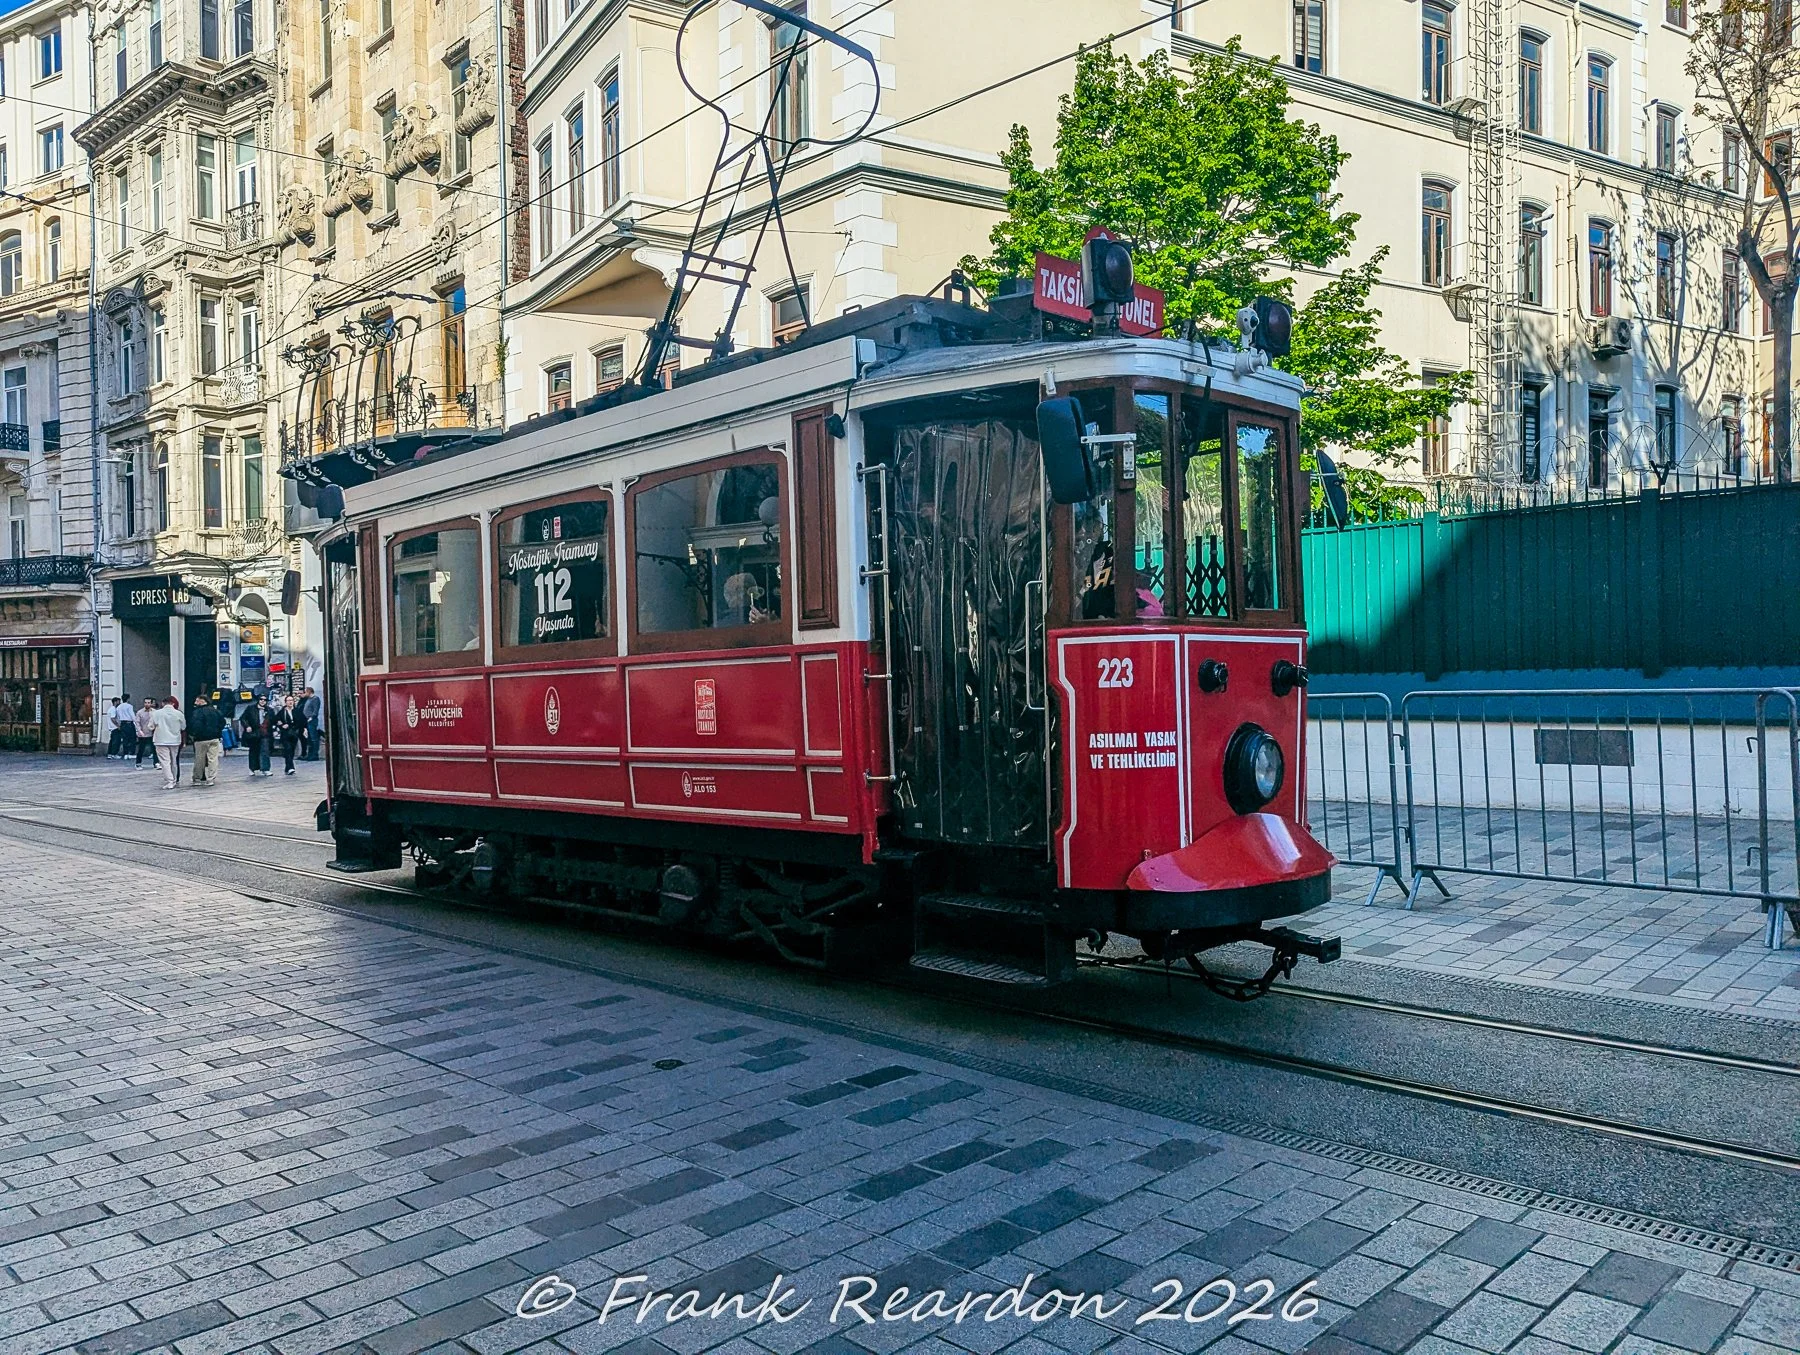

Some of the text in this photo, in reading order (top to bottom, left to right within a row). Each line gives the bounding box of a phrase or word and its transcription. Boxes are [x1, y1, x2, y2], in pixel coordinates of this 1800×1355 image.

[508, 541, 599, 575] Nostaljik Tramvay
[130, 587, 189, 606] ESPRESS LAB
[534, 567, 572, 615] 112
[534, 614, 574, 638] Yaşında
[1097, 657, 1134, 689] 223
[420, 703, 463, 722] BÜYÜKŞEHİR
[1144, 731, 1177, 747] YASAK
[1090, 749, 1176, 769] VE TEHLİKELİDİR
[706, 784, 717, 793] 153
